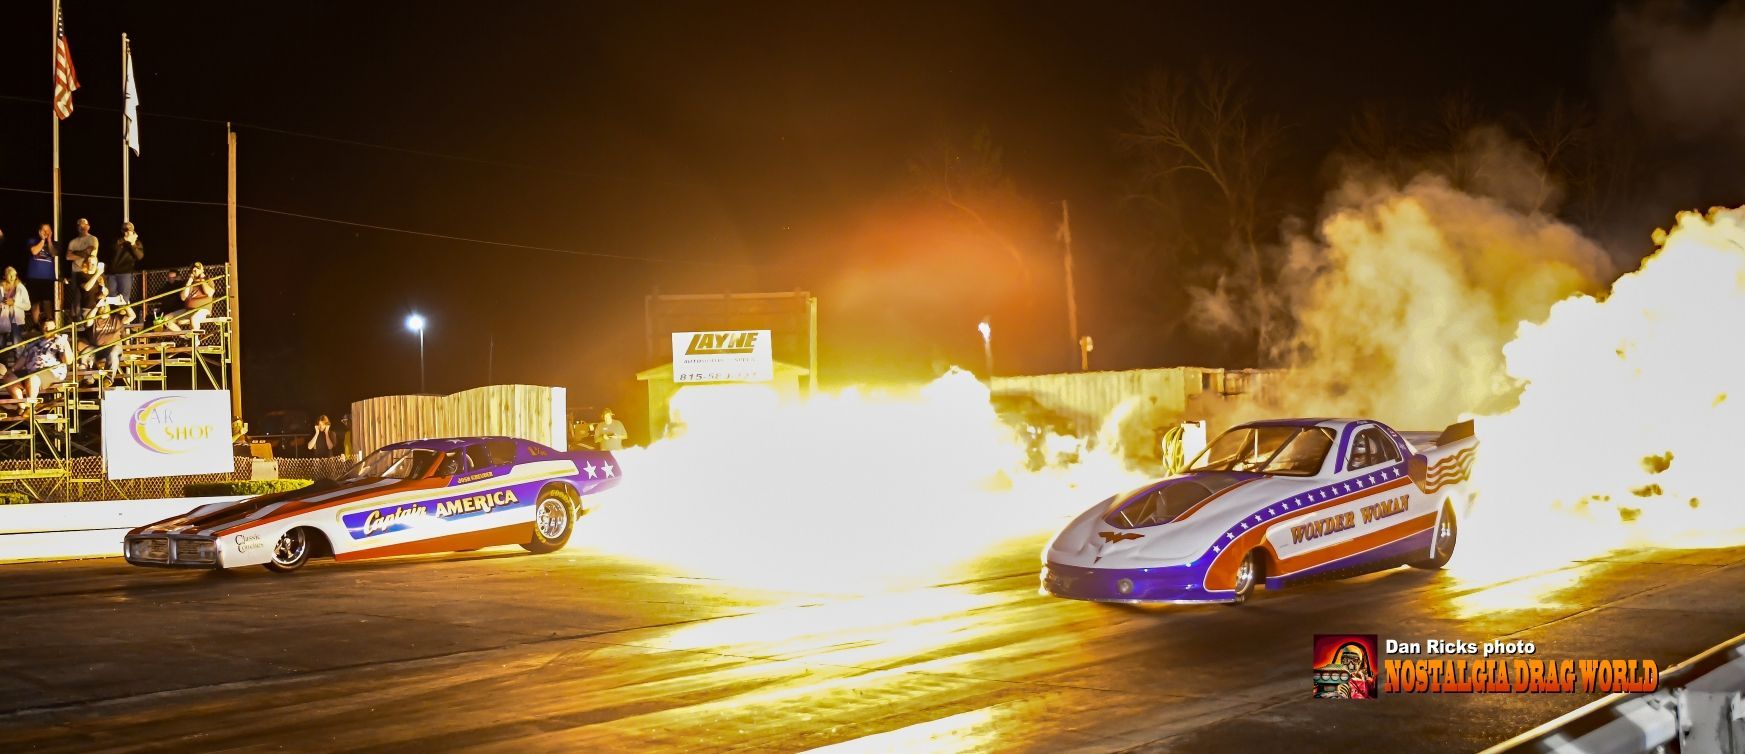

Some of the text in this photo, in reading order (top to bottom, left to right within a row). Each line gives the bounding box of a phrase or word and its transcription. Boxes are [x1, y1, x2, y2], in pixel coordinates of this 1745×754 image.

[685, 333, 758, 355] LAYNE
[164, 424, 214, 440] SHOP
[364, 490, 518, 535] Captain AMERICA
[1290, 494, 1410, 545] WONDER WOMAN
